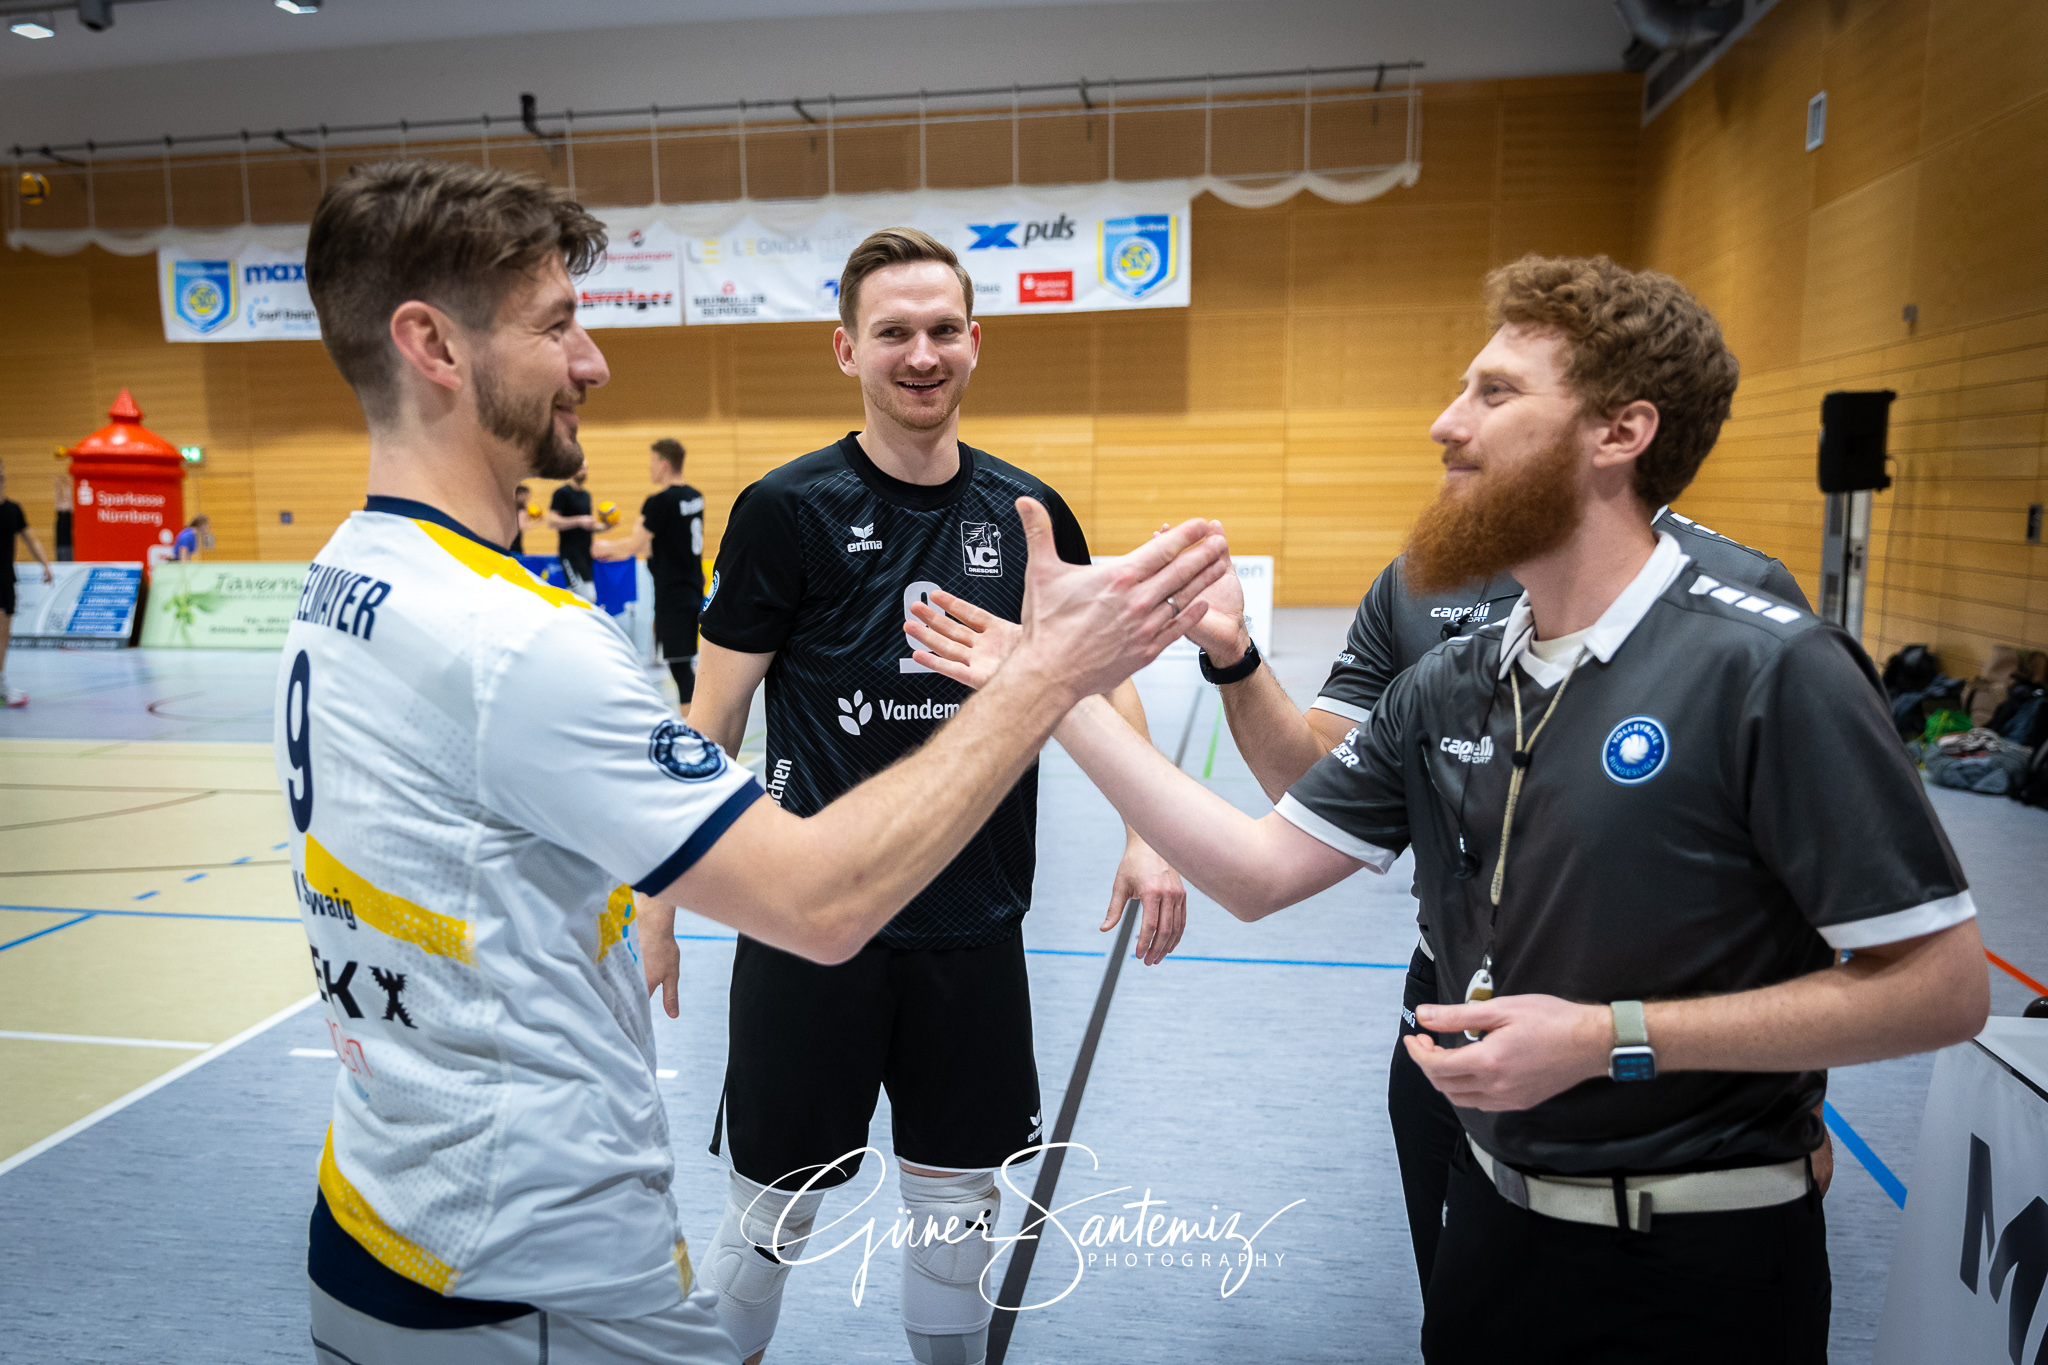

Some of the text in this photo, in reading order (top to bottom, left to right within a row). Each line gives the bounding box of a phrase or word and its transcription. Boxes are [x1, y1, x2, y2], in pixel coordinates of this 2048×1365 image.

[97, 490, 165, 508] Sparkasse
[97, 508, 163, 527] Nürnberg
[847, 538, 883, 553] erima
[965, 545, 998, 567] VC
[287, 650, 313, 833] 9
[1611, 723, 1661, 745] VOLLEYBALL
[1609, 755, 1656, 776] BUNDESLIGA
